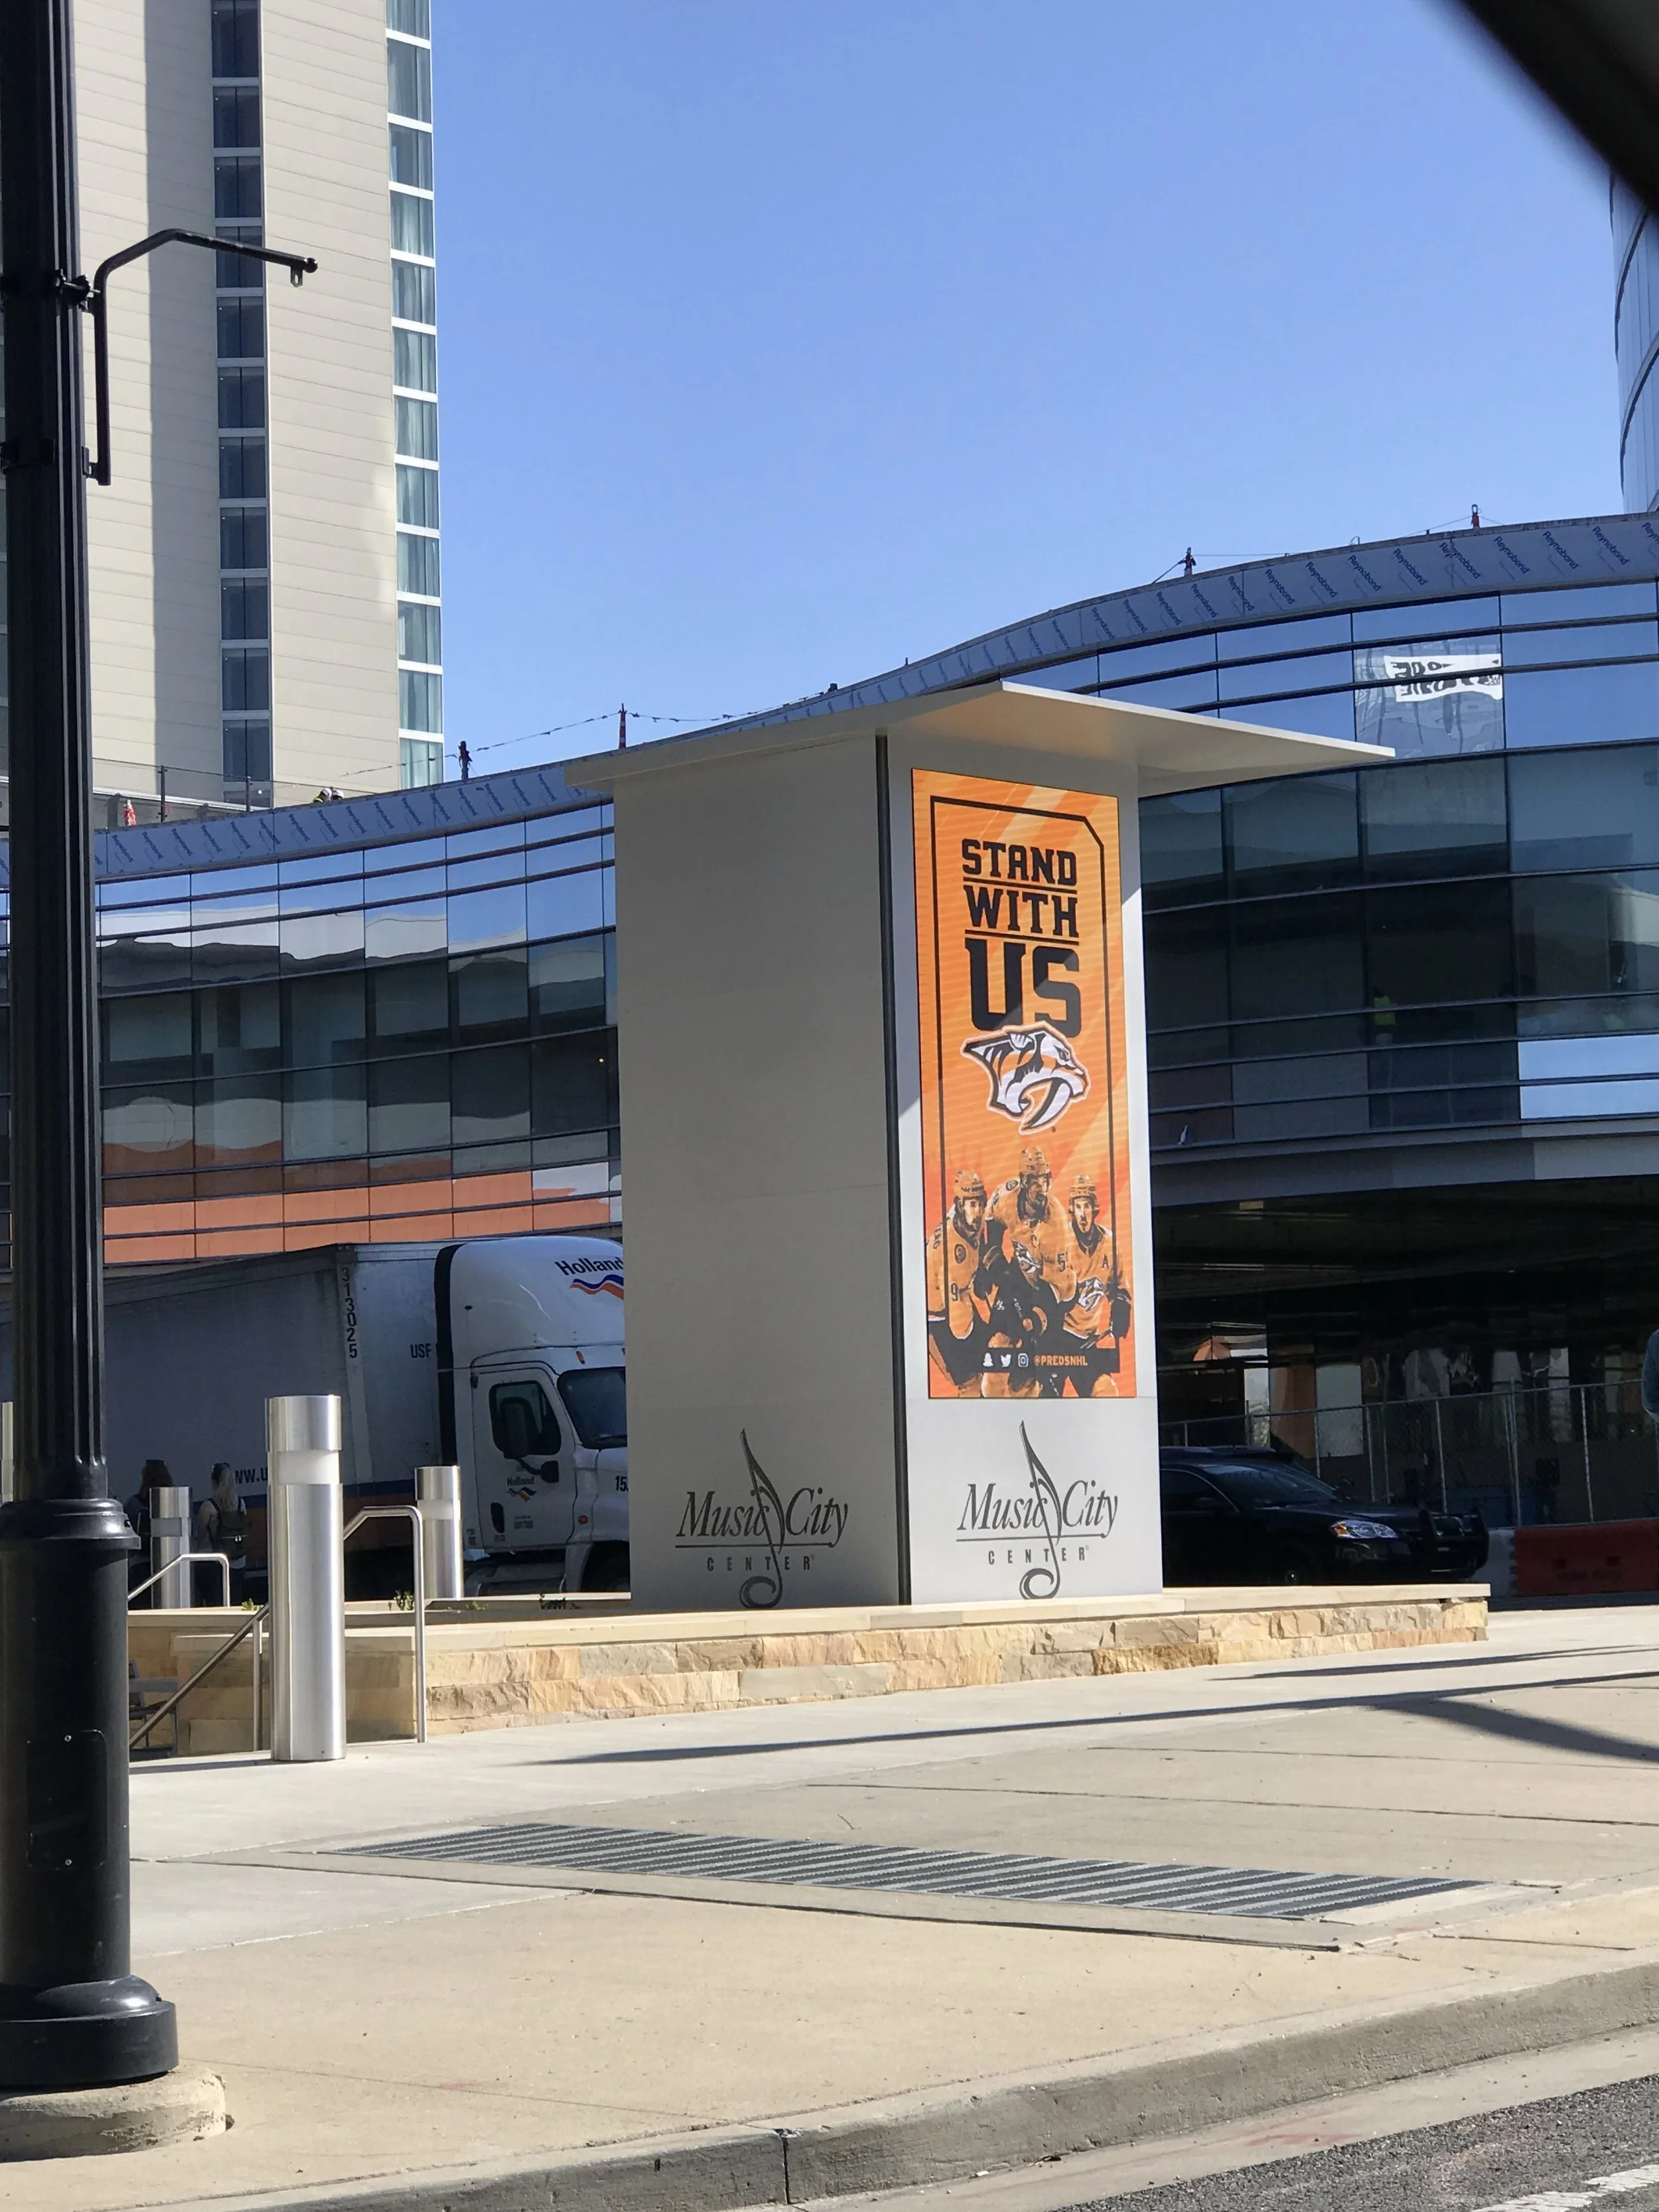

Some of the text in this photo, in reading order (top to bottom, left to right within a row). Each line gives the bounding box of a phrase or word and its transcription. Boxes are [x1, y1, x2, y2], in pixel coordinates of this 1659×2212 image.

[1494, 536, 1530, 574] Reynobond
[1543, 530, 1579, 569] Reynobond
[1593, 526, 1630, 565] Reynobond
[1305, 561, 1338, 597] Reynobond
[1348, 555, 1382, 592] Reynobond
[1394, 548, 1427, 585] Reynobond
[962, 838, 1077, 886] STAND
[964, 885, 1079, 937] WITH
[965, 937, 1082, 1039] US
[410, 1343, 431, 1359] USF
[676, 1487, 848, 1548] Music City
[956, 1479, 1118, 1538] Music City
[707, 1556, 810, 1572] CENTER
[989, 1546, 1085, 1565] CENTER
